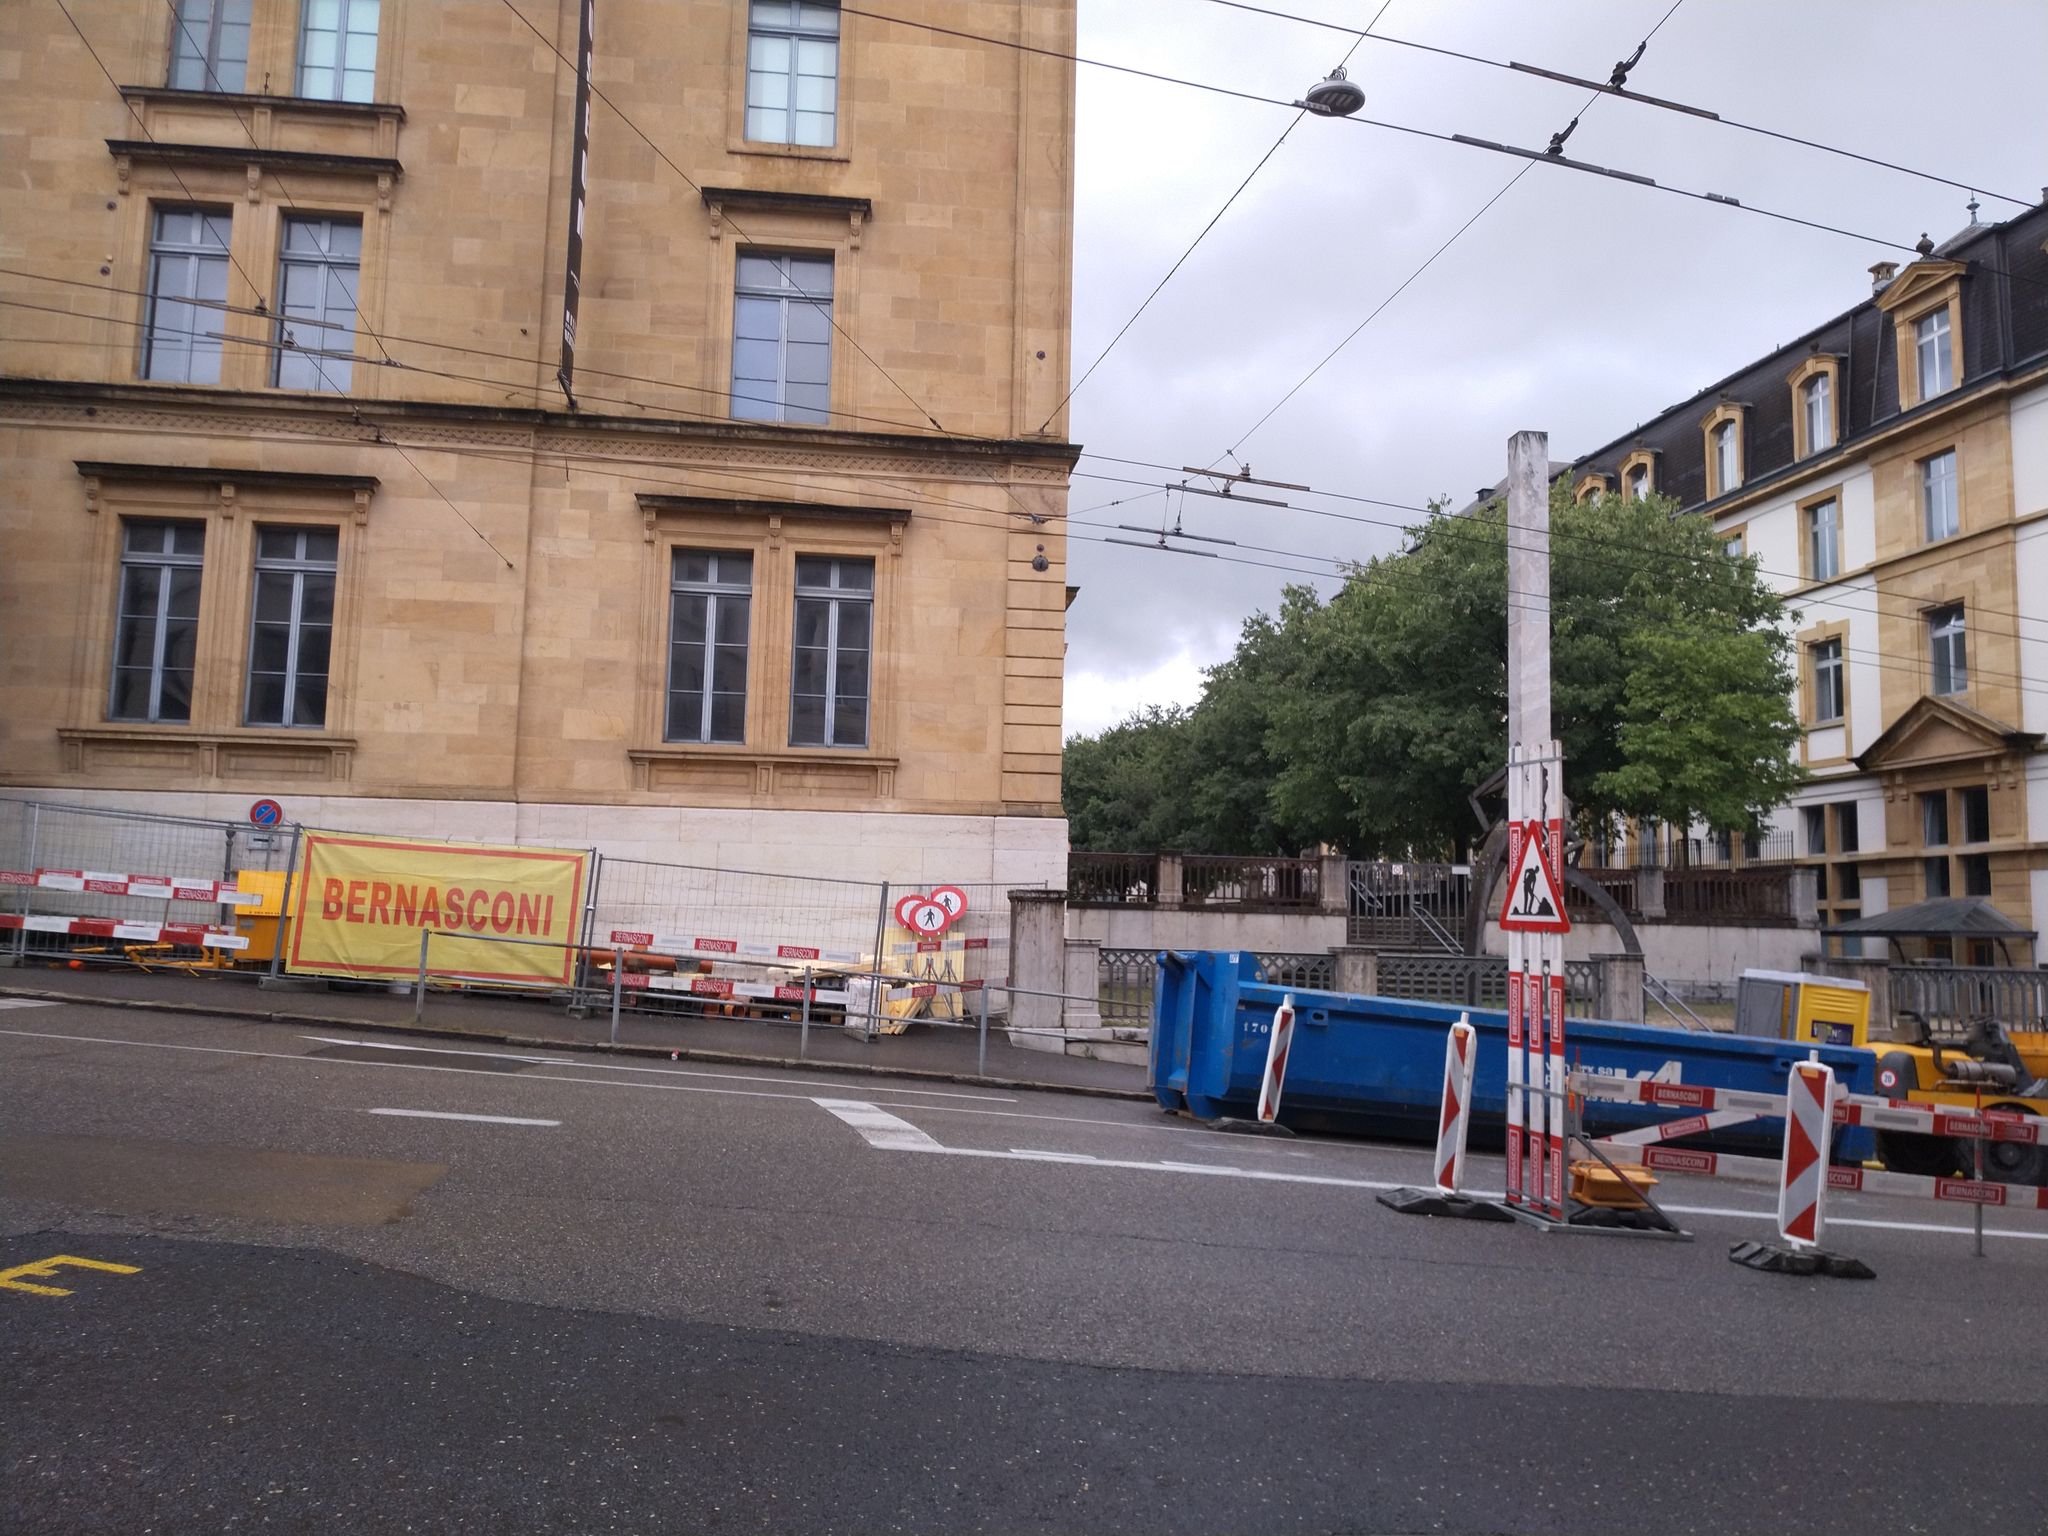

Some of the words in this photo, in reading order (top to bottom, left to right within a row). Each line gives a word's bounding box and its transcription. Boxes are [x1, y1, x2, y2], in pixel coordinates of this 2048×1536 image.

[322, 878, 553, 936] BERNASCONI
[615, 931, 649, 945] BERNASCONI
[698, 938, 733, 952] BERNASCONI
[782, 946, 815, 960] BERNASCONI
[1657, 1088, 1700, 1101] BERNASCONI
[1654, 1153, 1705, 1168] BERNASCONI
